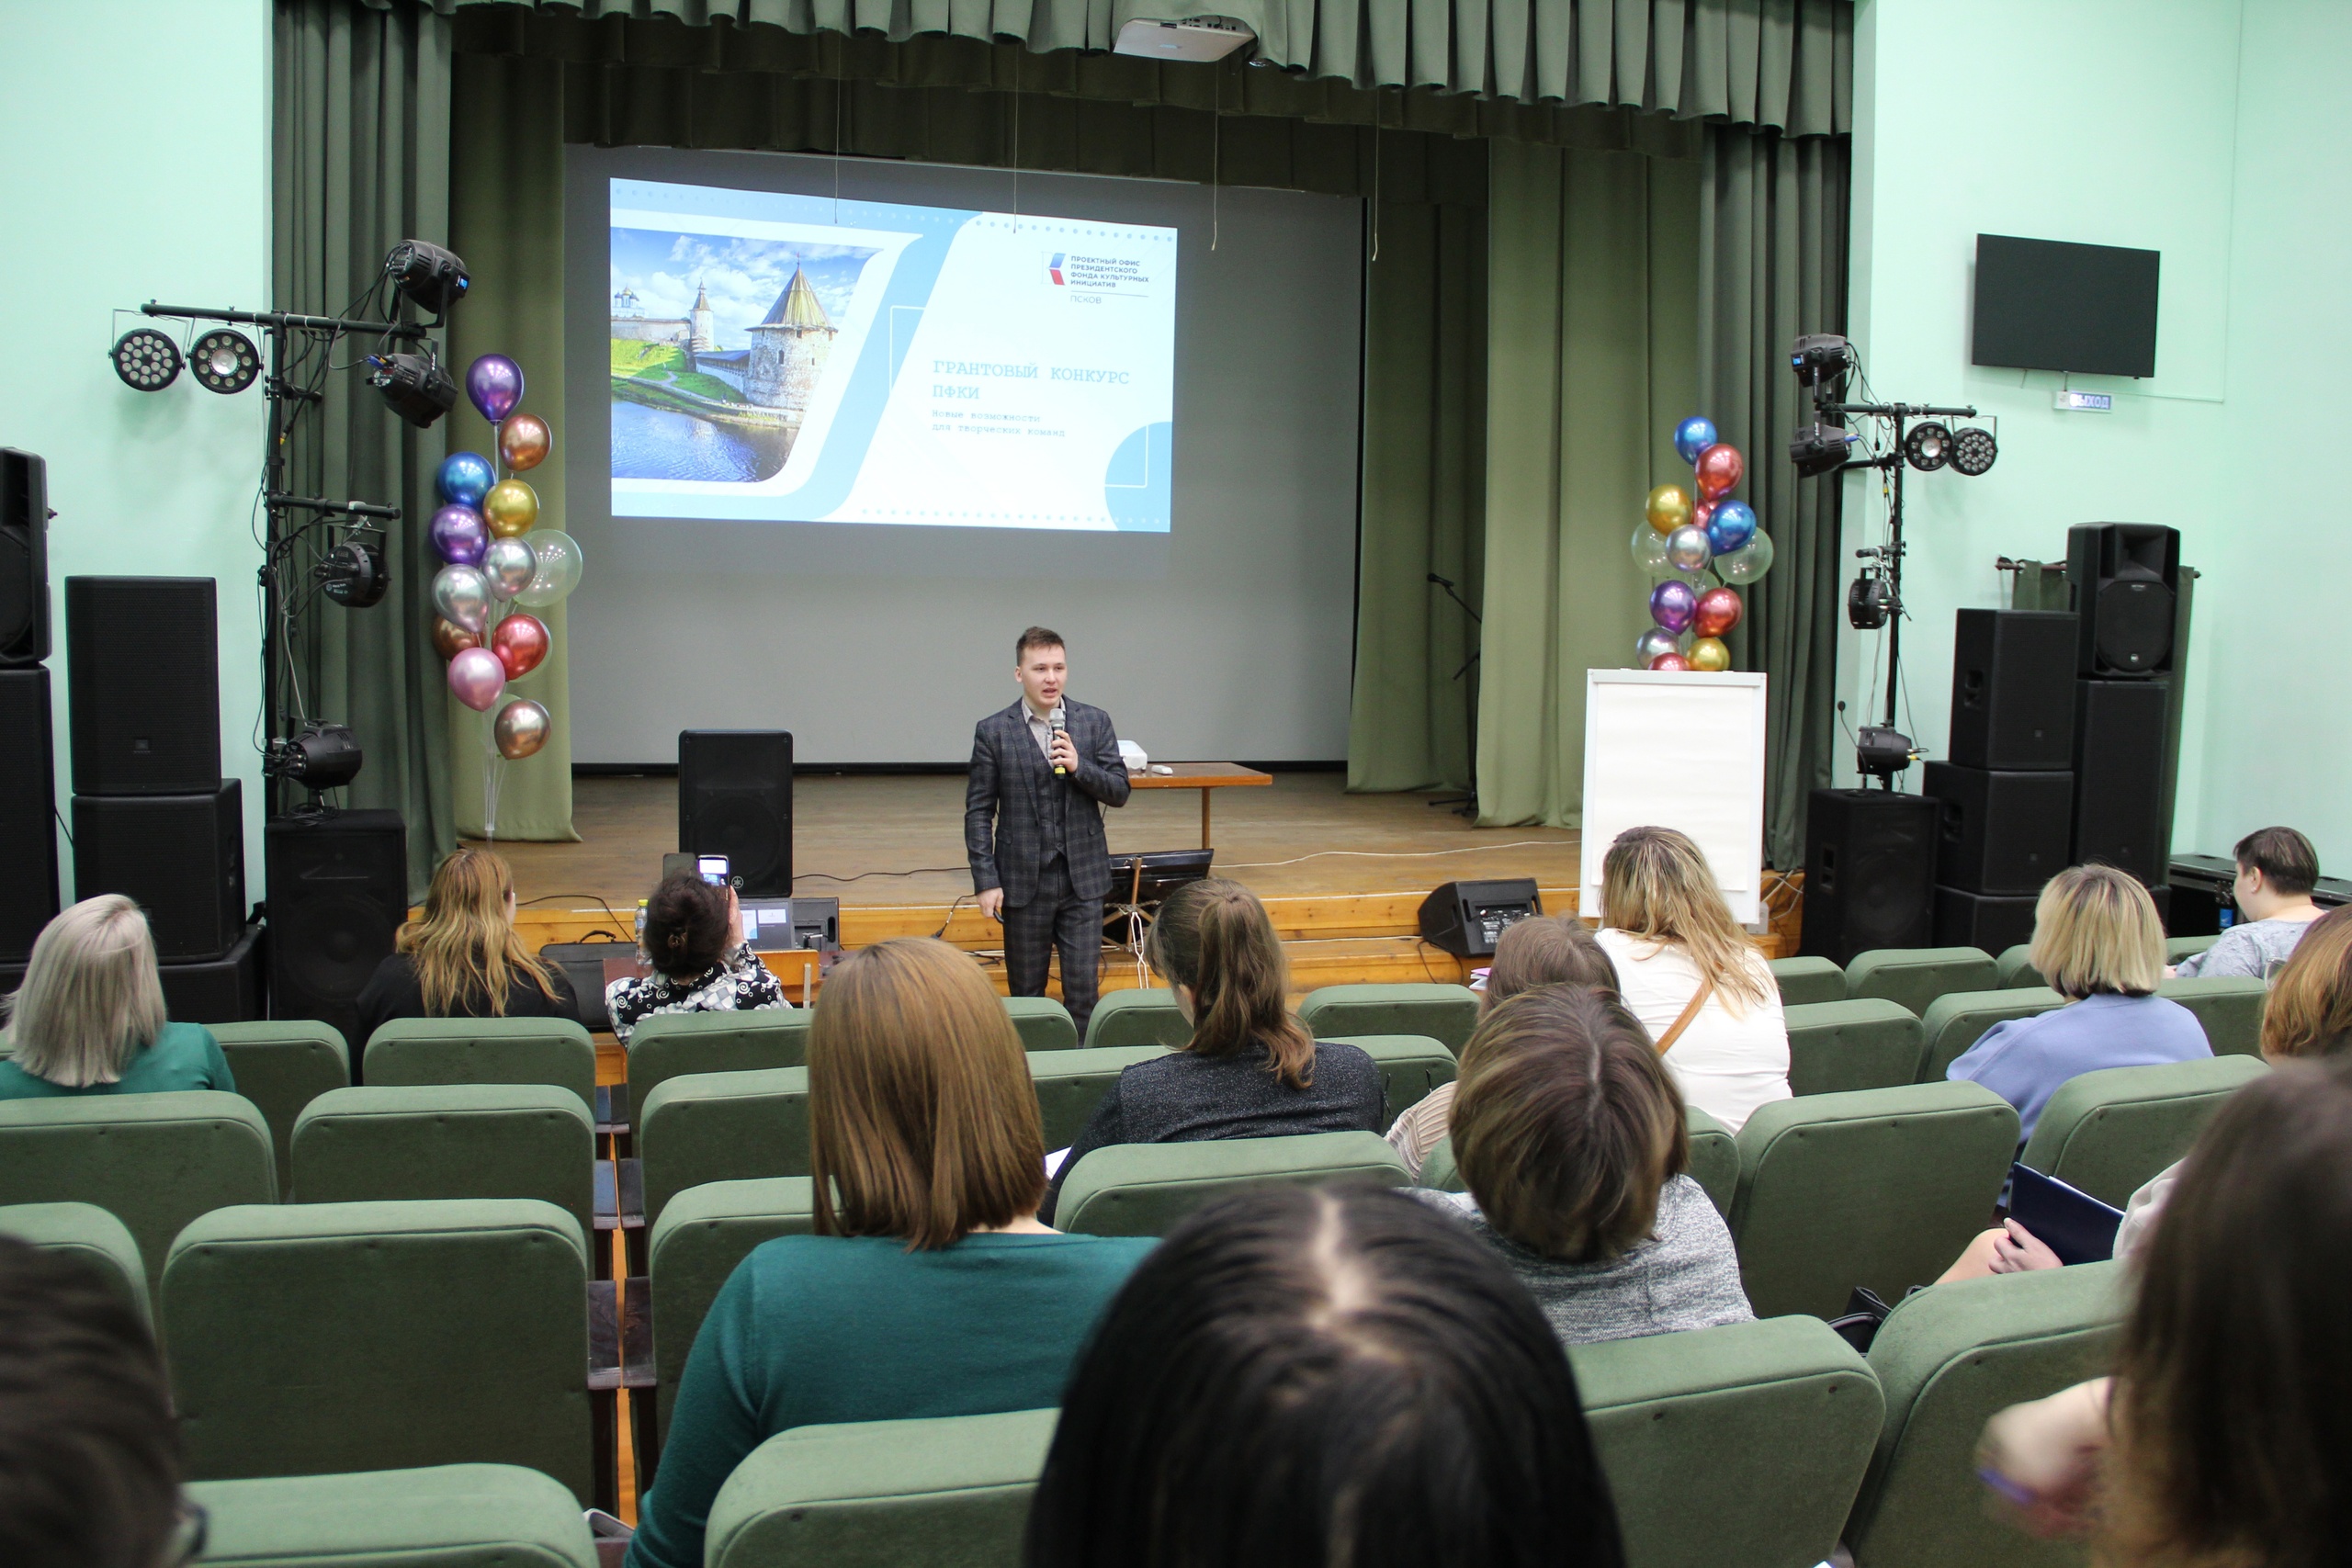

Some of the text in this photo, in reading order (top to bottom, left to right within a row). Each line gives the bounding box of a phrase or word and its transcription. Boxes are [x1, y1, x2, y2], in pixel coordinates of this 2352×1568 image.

[1071, 255, 1117, 265] ПРОЕКТНЫЙ
[1070, 264, 1138, 274] ПРЕЗИДЕНТСКОГО
[1070, 279, 1116, 288] ИНИЦИАТИВ
[1101, 274, 1149, 283] КУЛЬТУРНЫХ
[1070, 295, 1102, 304] ПСКОВ
[933, 360, 1129, 384] ГРАНТОВЫЙ КОНКУРС
[932, 385, 980, 399] ПФКИ
[932, 410, 1041, 423] Новые возможности
[932, 423, 1066, 437] для творческих команд
